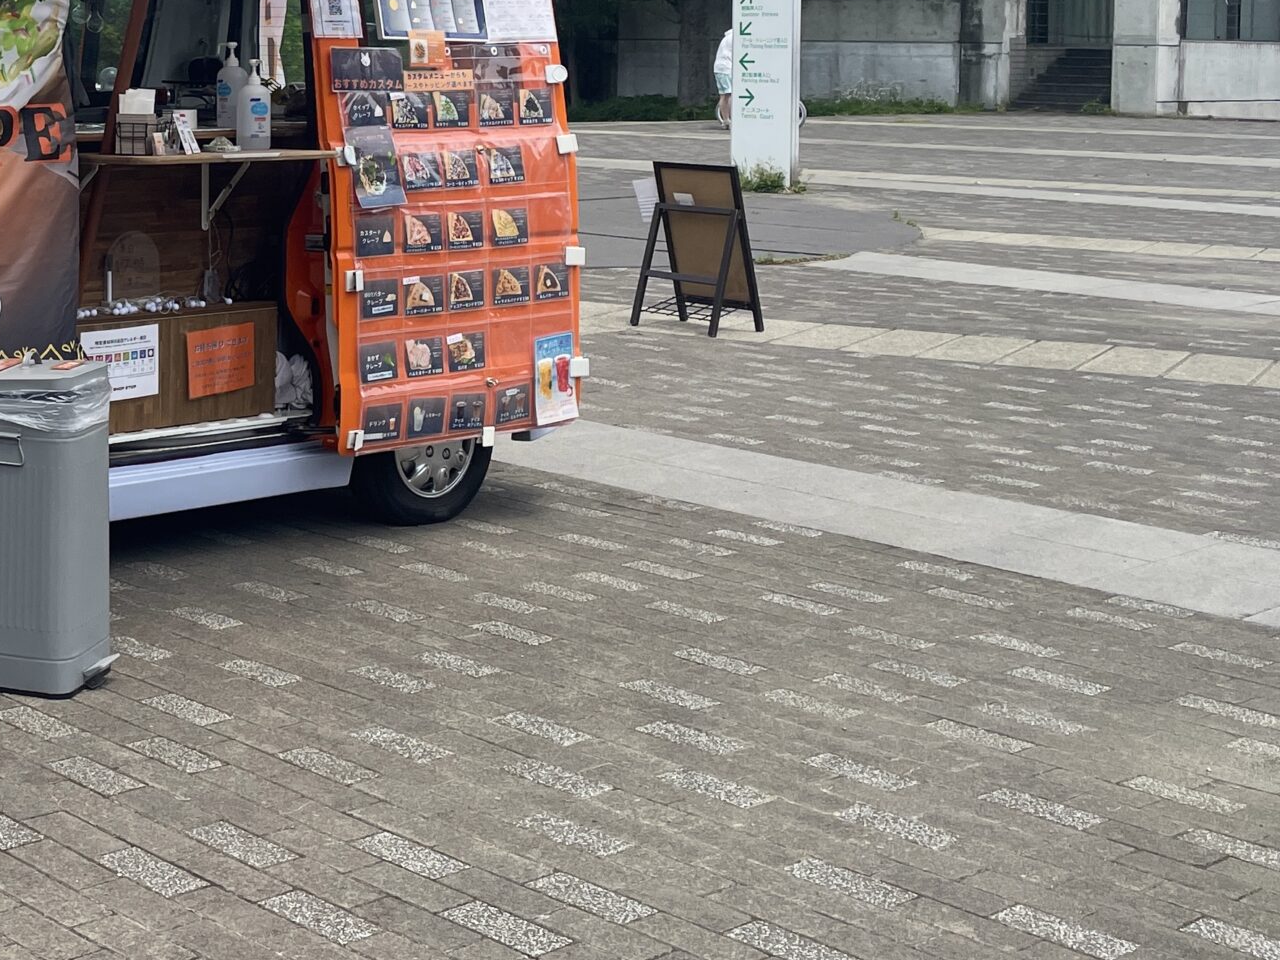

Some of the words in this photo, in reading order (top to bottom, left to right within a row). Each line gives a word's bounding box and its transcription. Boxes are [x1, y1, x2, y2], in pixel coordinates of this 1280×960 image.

[334, 79, 403, 90] おすすめカスタム
[365, 362, 382, 370] クレープ
[369, 420, 386, 428] ドリンク
